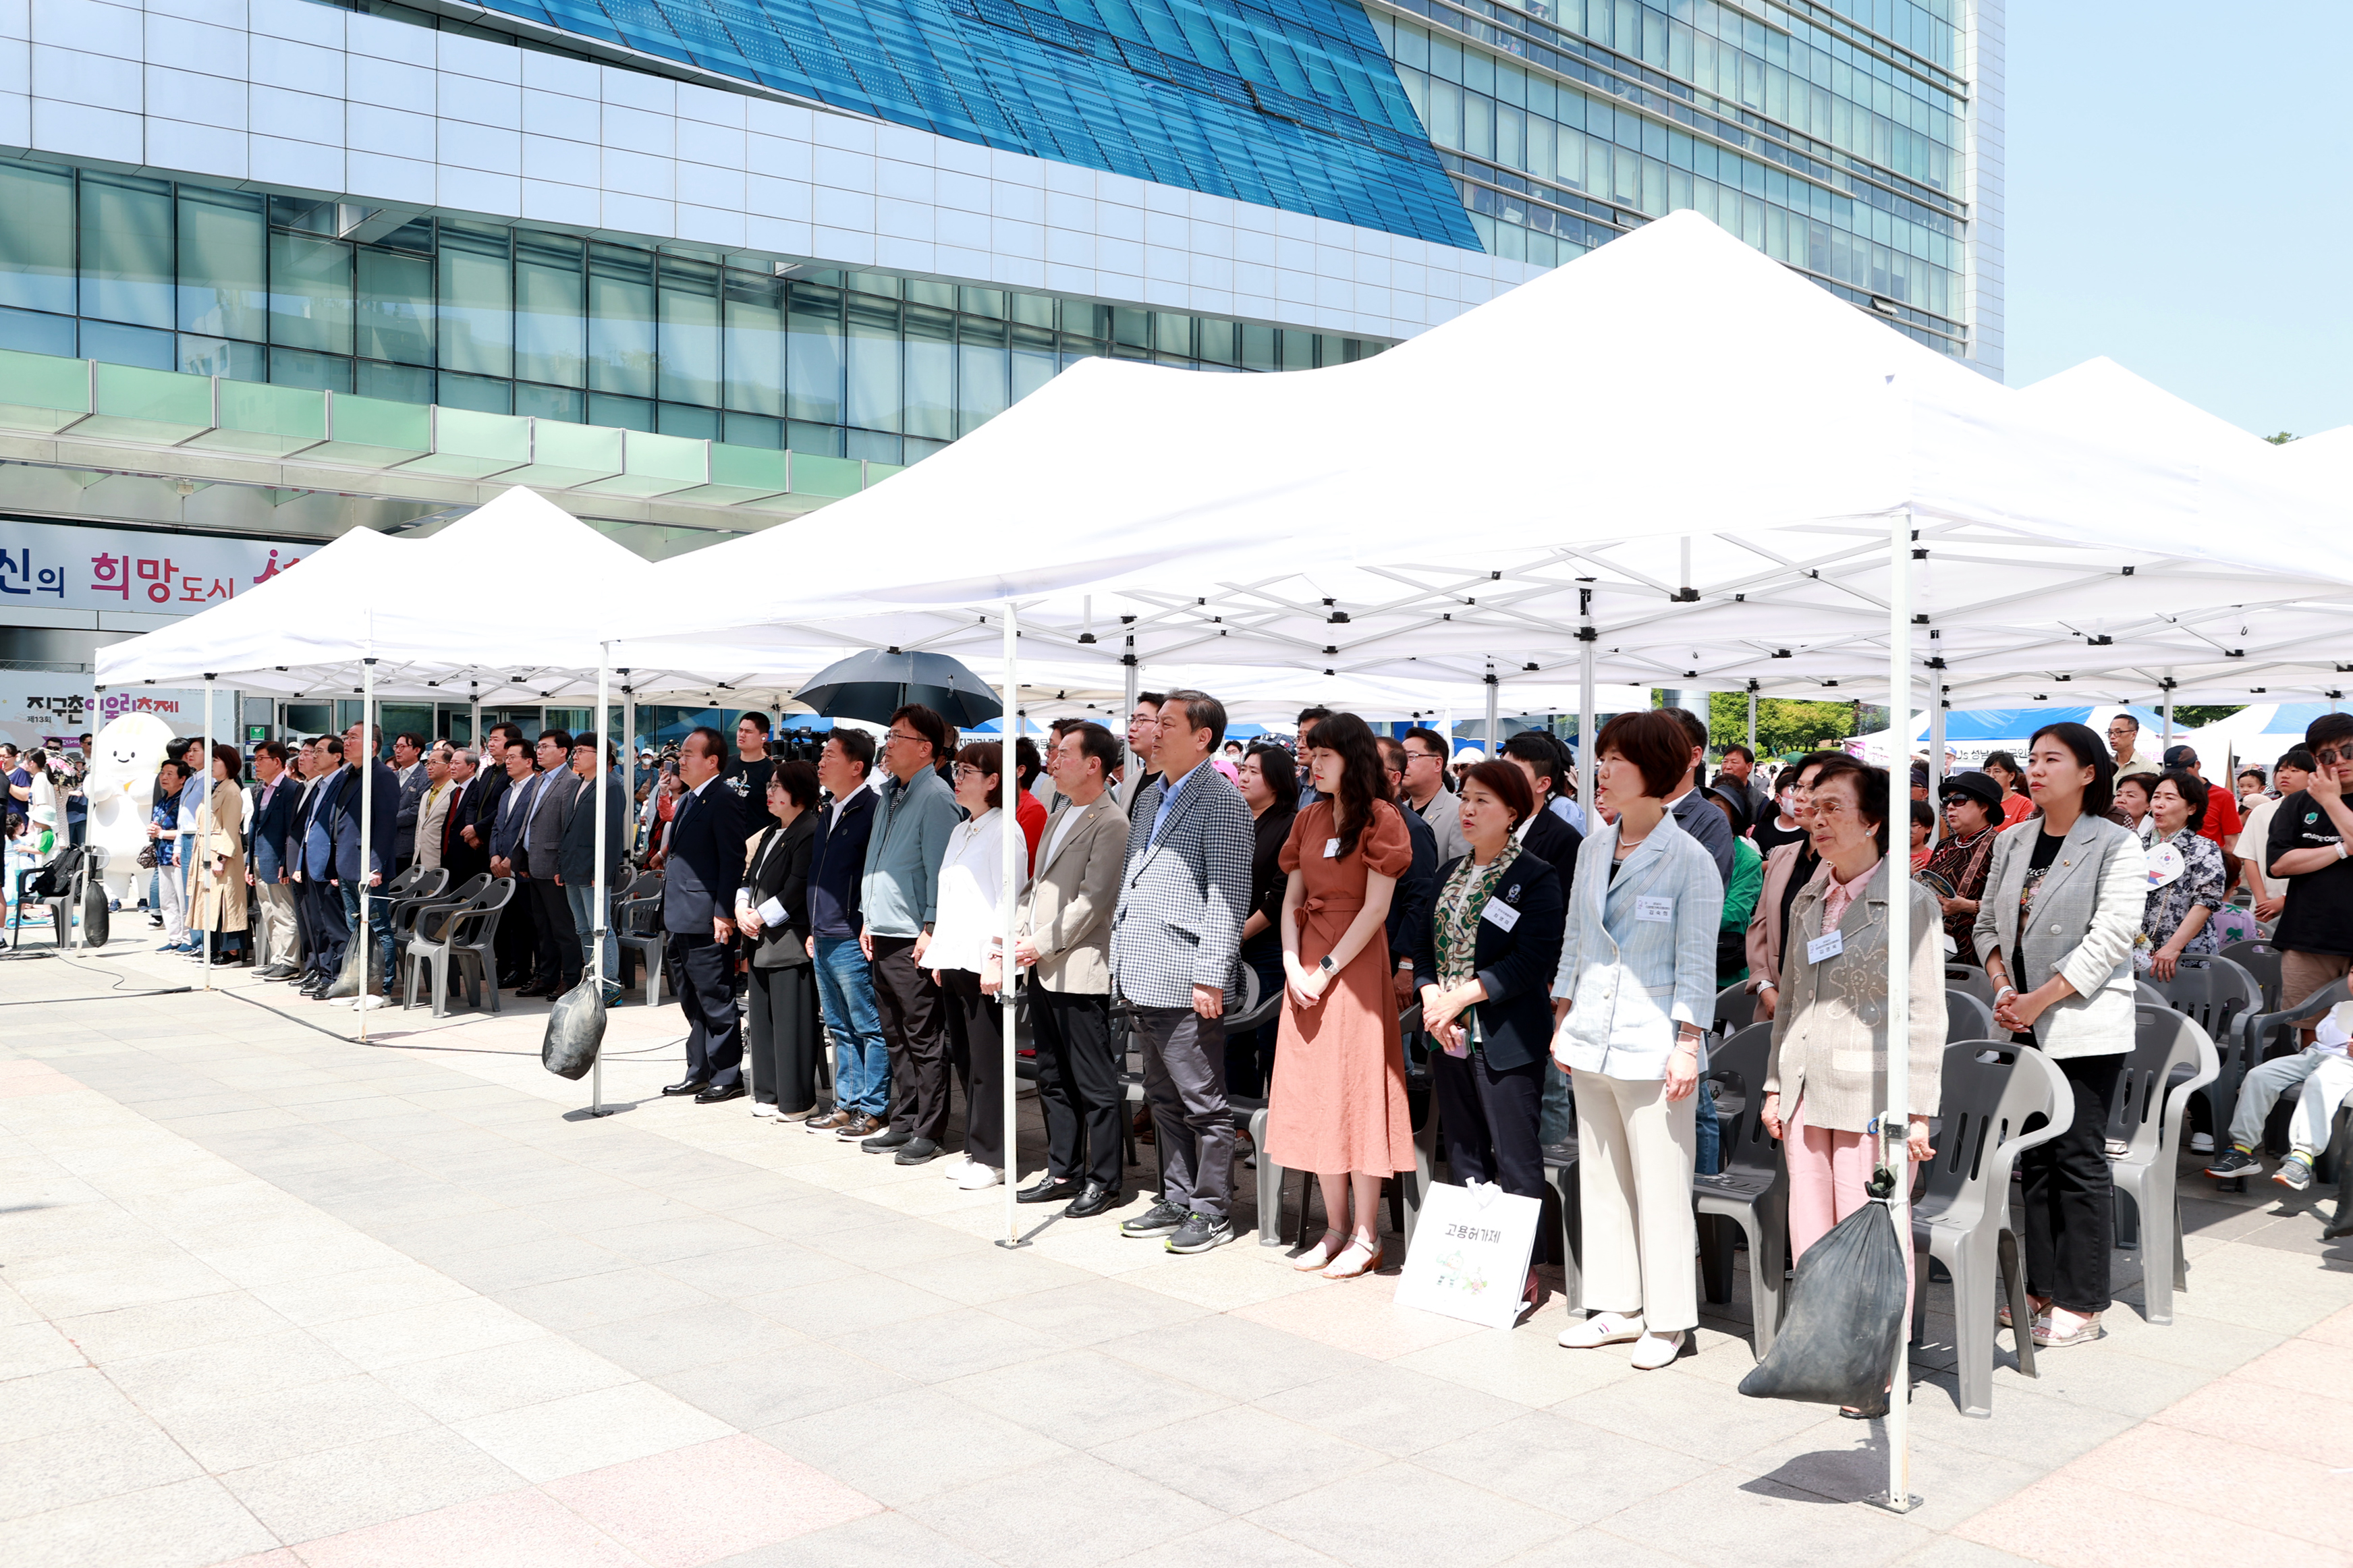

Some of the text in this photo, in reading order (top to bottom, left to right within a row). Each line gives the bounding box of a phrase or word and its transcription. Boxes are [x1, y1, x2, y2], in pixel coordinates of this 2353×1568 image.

[91, 552, 233, 603] 희망도시
[27, 715, 52, 724] 제13회
[1445, 1223, 1501, 1244] 고용허가제
